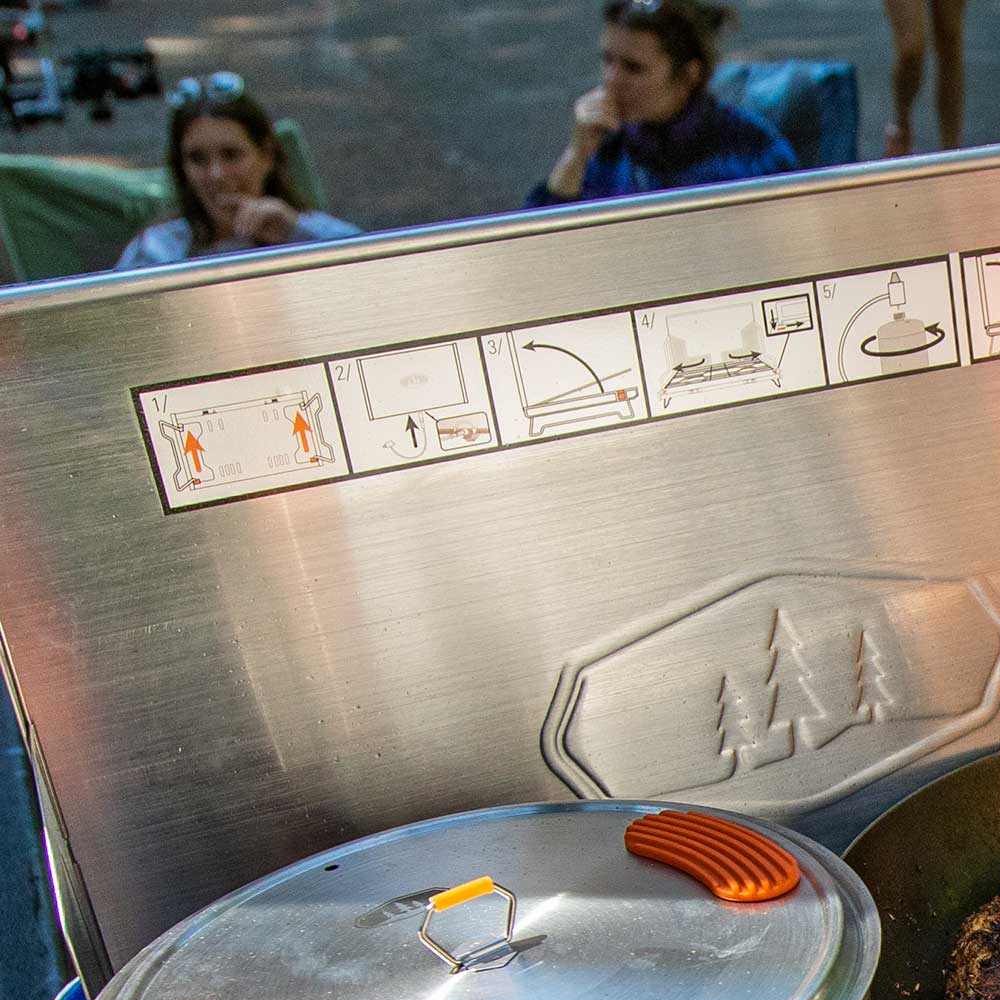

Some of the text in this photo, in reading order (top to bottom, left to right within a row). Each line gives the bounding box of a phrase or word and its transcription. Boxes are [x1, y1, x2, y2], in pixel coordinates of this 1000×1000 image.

[823, 283, 836, 300] 5/
[641, 312, 655, 330] 4/
[487, 338, 503, 355] 3/
[335, 364, 351, 382] 2/
[152, 394, 168, 414] 1/
